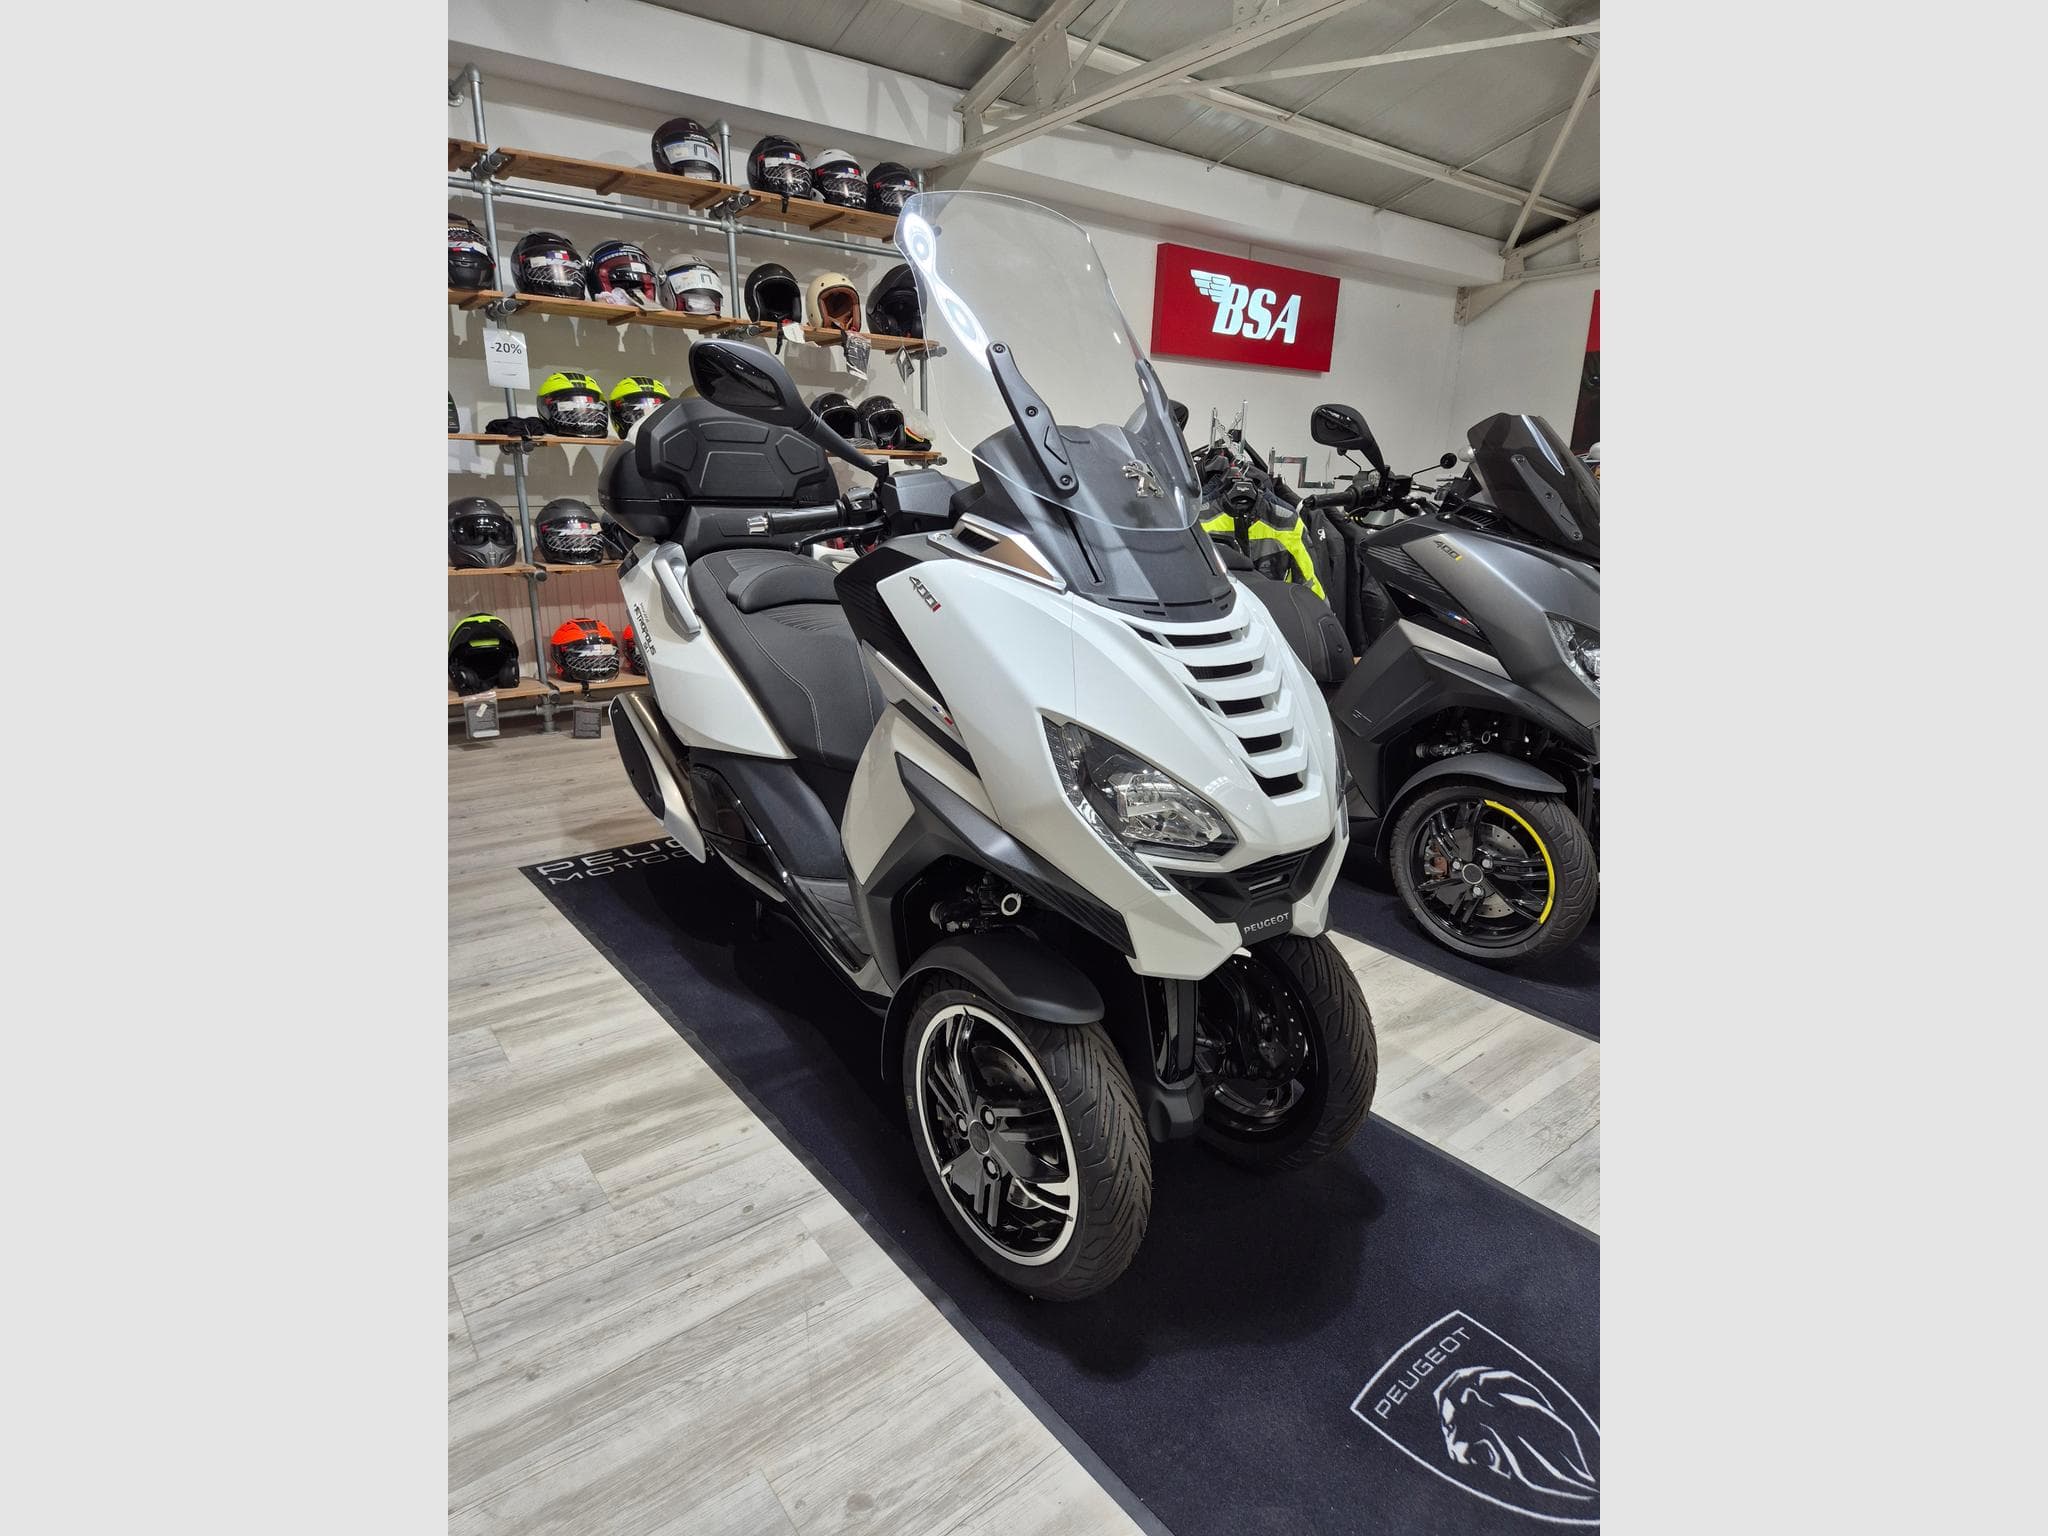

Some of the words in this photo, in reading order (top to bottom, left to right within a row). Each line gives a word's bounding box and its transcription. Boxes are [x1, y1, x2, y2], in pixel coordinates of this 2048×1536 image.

[1211, 282, 1302, 344] BSA
[490, 341, 522, 355] -20%
[1243, 912, 1289, 934] PEUGEOT
[1374, 1327, 1471, 1420] PEUGEOT
